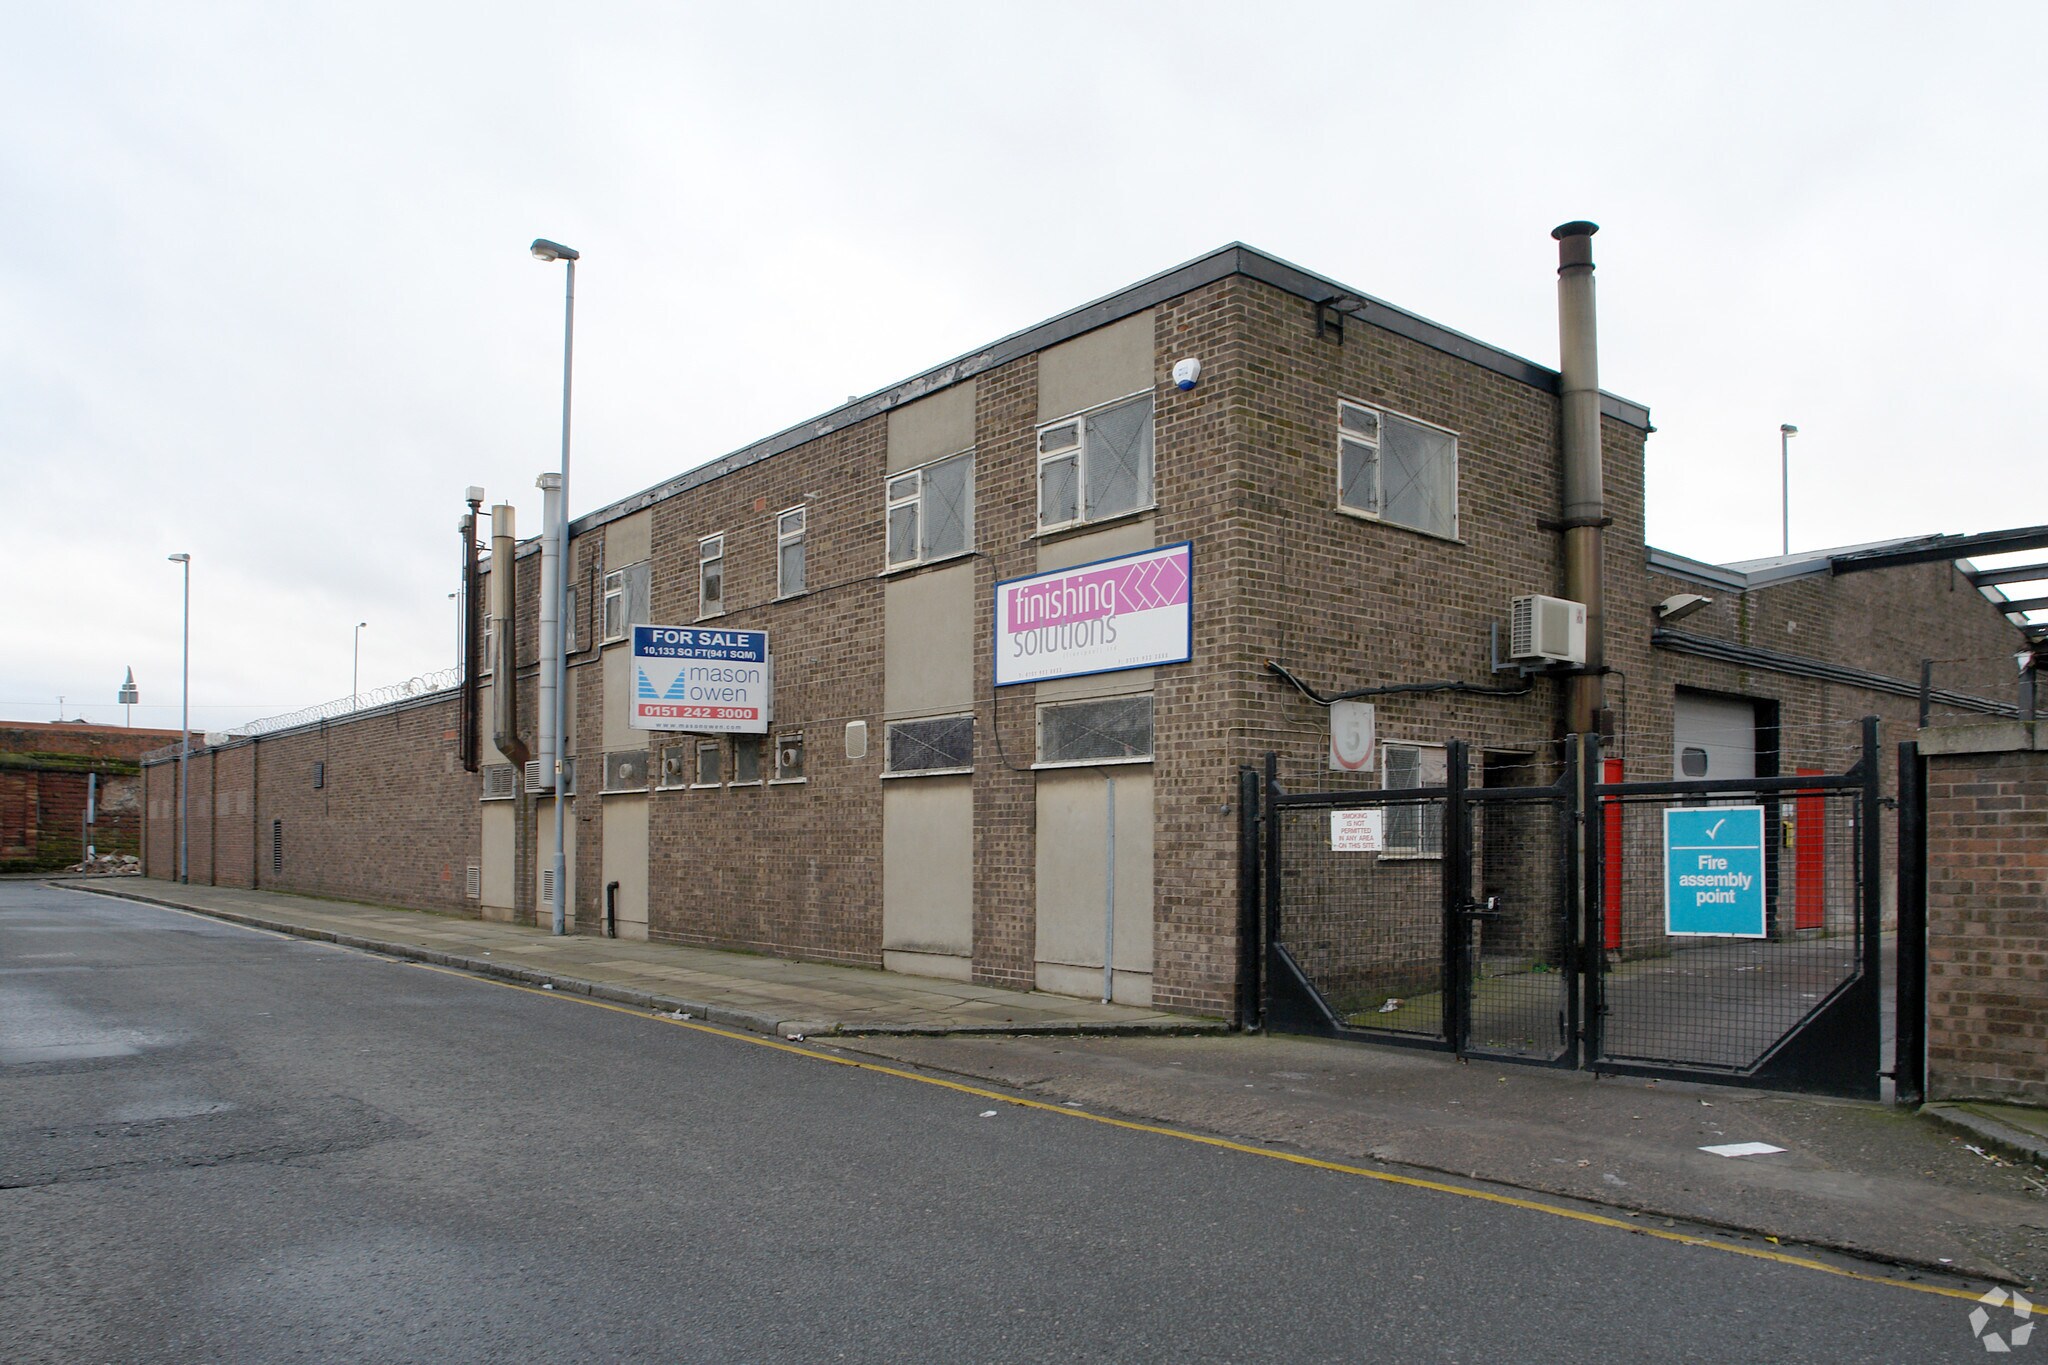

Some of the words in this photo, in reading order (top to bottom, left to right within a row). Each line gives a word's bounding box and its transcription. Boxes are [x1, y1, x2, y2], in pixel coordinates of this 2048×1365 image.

[1016, 576, 1115, 624] finishing
[652, 630, 693, 645] FOR
[699, 633, 749, 647] SALE
[1014, 614, 1117, 658] solutions
[643, 646, 675, 656] 10,133
[677, 649, 693, 657] SQ
[730, 650, 757, 660] SQM)
[690, 667, 759, 684] mason
[690, 686, 746, 702] owen
[645, 706, 677, 717] 0151
[683, 707, 711, 718] 242
[717, 708, 752, 719] 3000
[656, 722, 742, 730] www.masonowen.com
[1345, 721, 1360, 751] 5
[1698, 855, 1728, 870] Fire
[1679, 872, 1752, 891] assembly
[1696, 888, 1736, 907] point
